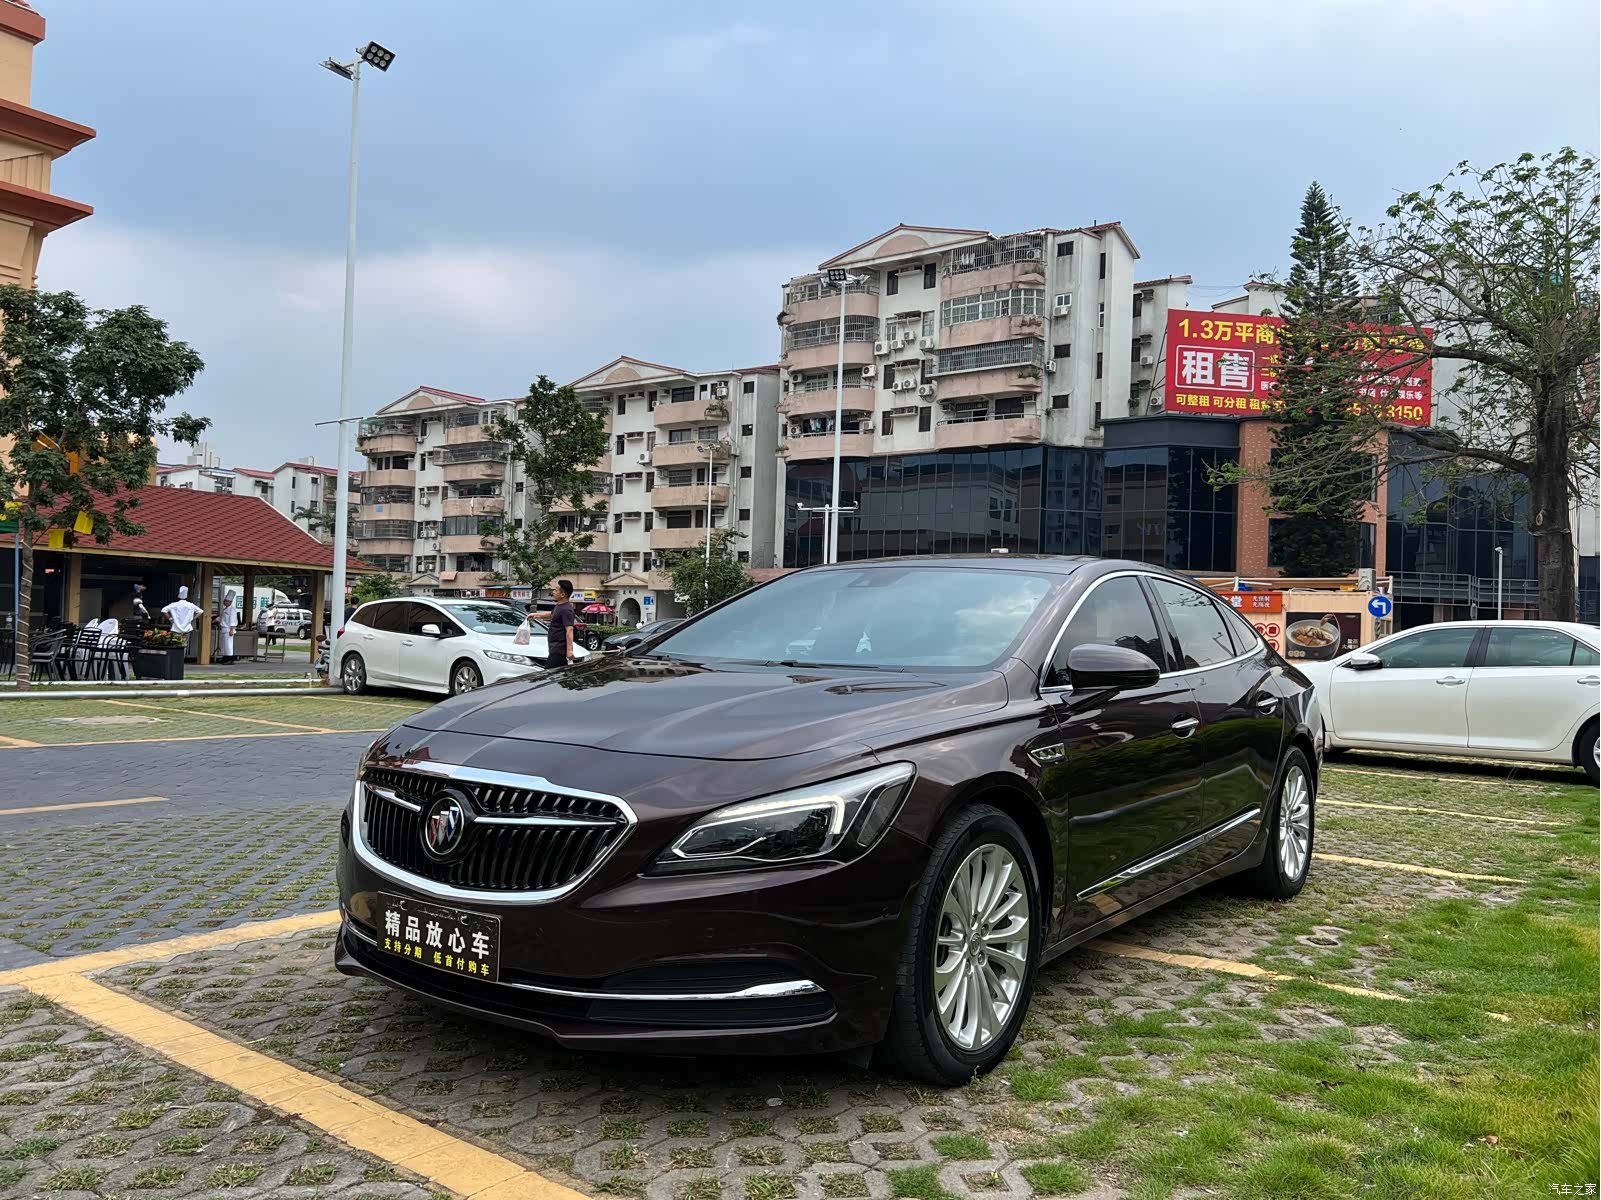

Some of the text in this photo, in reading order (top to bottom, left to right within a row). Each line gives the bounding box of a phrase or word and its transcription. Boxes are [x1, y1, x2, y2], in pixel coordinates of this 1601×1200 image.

[1179, 318, 1292, 345] 1.3万平商
[1181, 350, 1249, 388] 租售
[1176, 393, 1210, 407] 可整租
[1213, 396, 1247, 409] 可分租
[385, 910, 490, 959] 精品放心车
[384, 938, 489, 976] 支持分期 低首付购车
